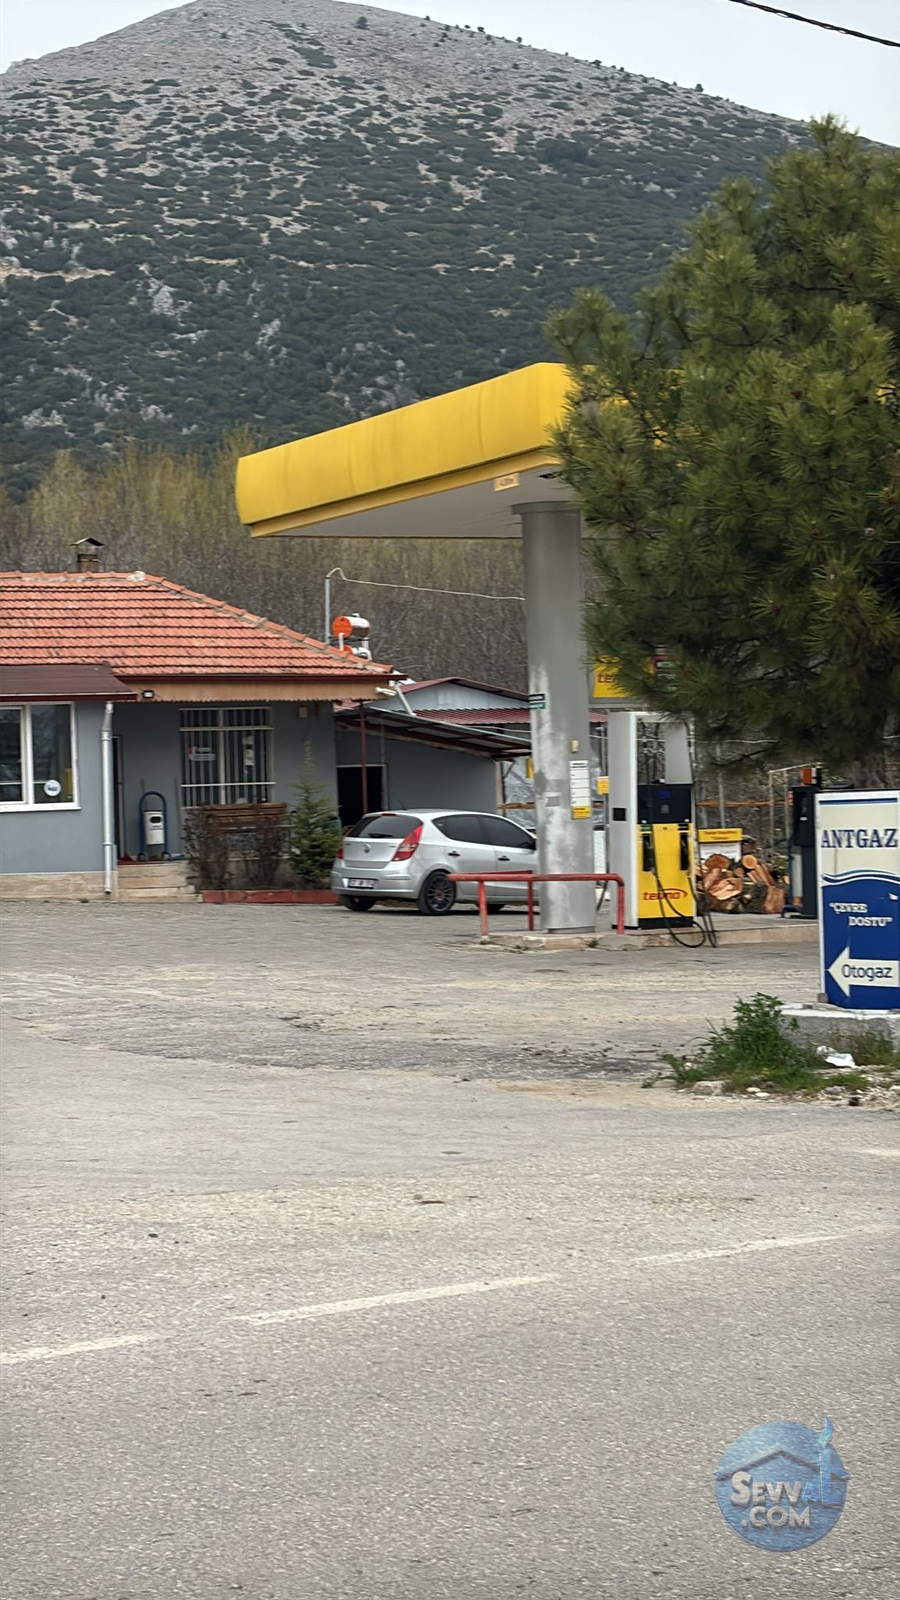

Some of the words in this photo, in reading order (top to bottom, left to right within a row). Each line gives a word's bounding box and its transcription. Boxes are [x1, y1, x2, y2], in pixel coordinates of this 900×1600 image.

[821, 828, 898, 848] ANTGAZ
[848, 916, 893, 927] DOSTU"
[842, 964, 893, 982] Otogaz
